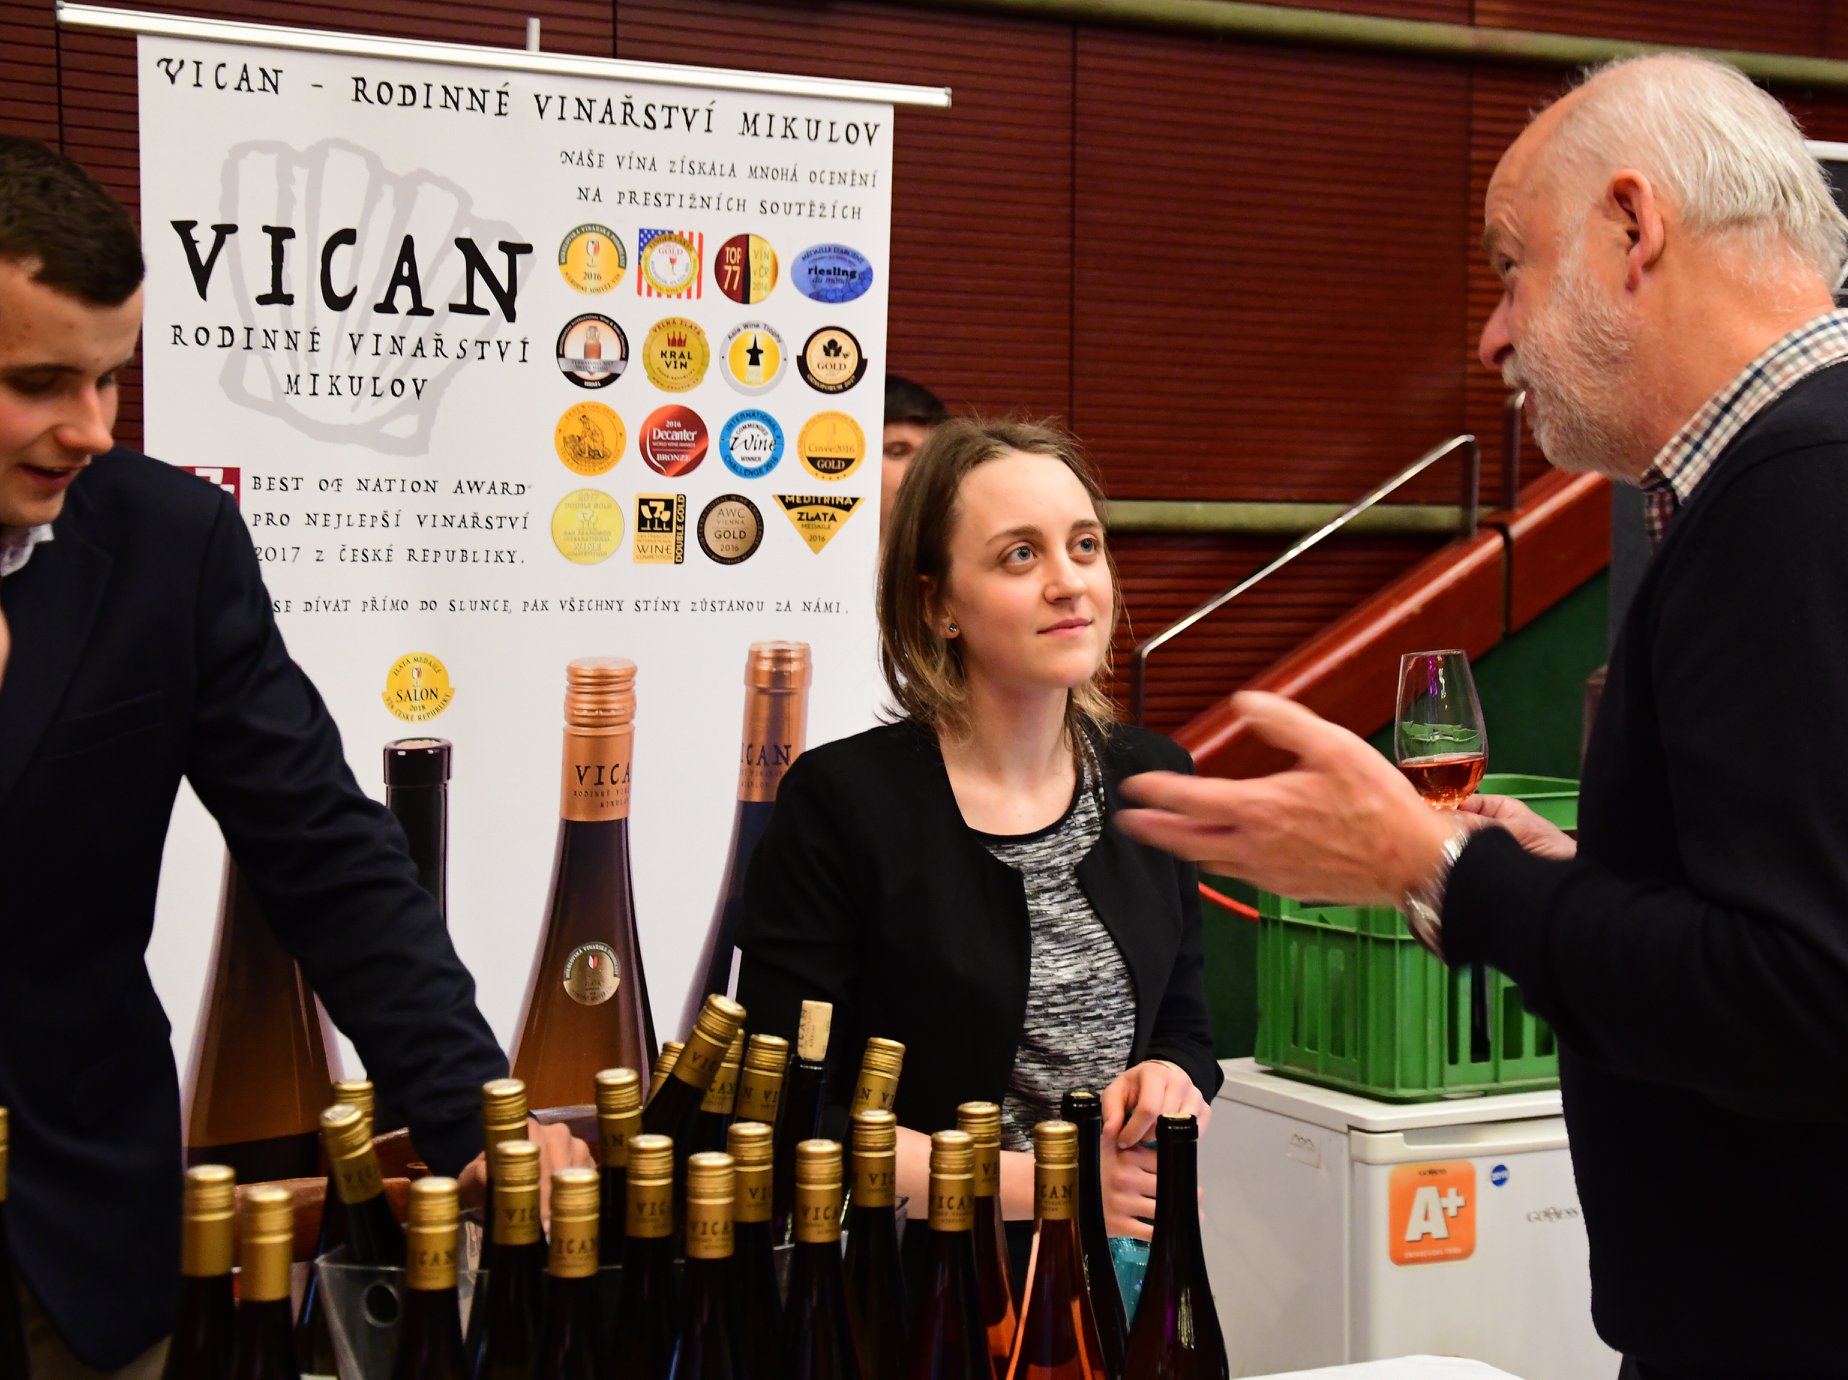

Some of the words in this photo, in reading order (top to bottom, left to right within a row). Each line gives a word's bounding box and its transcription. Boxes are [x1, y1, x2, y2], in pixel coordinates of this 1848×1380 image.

[156, 57, 284, 96] VICAN
[350, 76, 514, 118] RODINNÉ
[533, 92, 719, 134] VINAŘSTVÍ
[737, 111, 881, 147] MIKULOV
[559, 149, 606, 170] NAŠE
[616, 151, 657, 173] VÍNA
[668, 155, 738, 179] ZÍSKALA
[747, 162, 800, 184] MNOHÁ
[808, 169, 878, 189] OCENĚNÍ
[576, 187, 603, 203] NA
[616, 190, 748, 213] PRESTIŽNÍCH
[759, 199, 863, 221] SOUTĚŽÍCH
[726, 247, 742, 264] TOP
[169, 219, 534, 323] VICAN
[583, 270, 602, 281] 2016
[723, 266, 740, 290] 77
[808, 266, 857, 280] riesling
[728, 327, 741, 341] Asia
[742, 322, 760, 330] Wine
[763, 323, 782, 344] Trophy
[170, 324, 321, 353] RODINNÉ
[348, 332, 530, 364] VINAŘSTVÍ
[817, 362, 847, 371] GOLD
[283, 372, 429, 400] MIKULOV
[666, 420, 682, 428] 2016
[726, 412, 778, 432] INTERNATIONAL
[735, 422, 769, 436] COMMENDED
[652, 428, 698, 442] Decanter
[730, 434, 777, 451] Wine
[656, 454, 690, 462] BRONZE
[725, 456, 763, 477] CHALLENGE
[816, 458, 846, 470] GOLD
[251, 475, 304, 492] BEST
[355, 477, 440, 494] NATION
[676, 494, 686, 520] GOLD
[785, 495, 854, 506] MEDITRINA
[251, 511, 291, 527] PRO
[304, 509, 403, 530] NEJLEPŠÍ
[416, 511, 530, 531] VINAŘSTVÍ
[717, 508, 746, 519] AWC
[796, 510, 838, 522] ZLATÁ
[675, 524, 683, 563] DOUBLE
[714, 530, 747, 540] GOLD
[808, 534, 826, 543] 2016
[256, 546, 301, 563] 2017
[338, 543, 394, 563] ČESKÉ
[405, 547, 525, 564] REPUBLIKY.
[636, 544, 673, 554] WINE
[720, 544, 740, 552] 2016
[273, 600, 291, 613] SE
[302, 596, 352, 613] DÍVAT
[360, 595, 409, 613] PŘÍMO
[418, 599, 438, 612] DO
[448, 598, 513, 615] SLUNCE,
[522, 598, 550, 613] PAK
[559, 597, 625, 613] VŠECHNY
[634, 597, 682, 613] STÍNY
[690, 598, 765, 613] ZŮSTANOU
[775, 600, 792, 613] ZA
[801, 598, 849, 614] NÁMI.
[396, 688, 438, 703] SALON
[1405, 1186, 1465, 1242] A+
